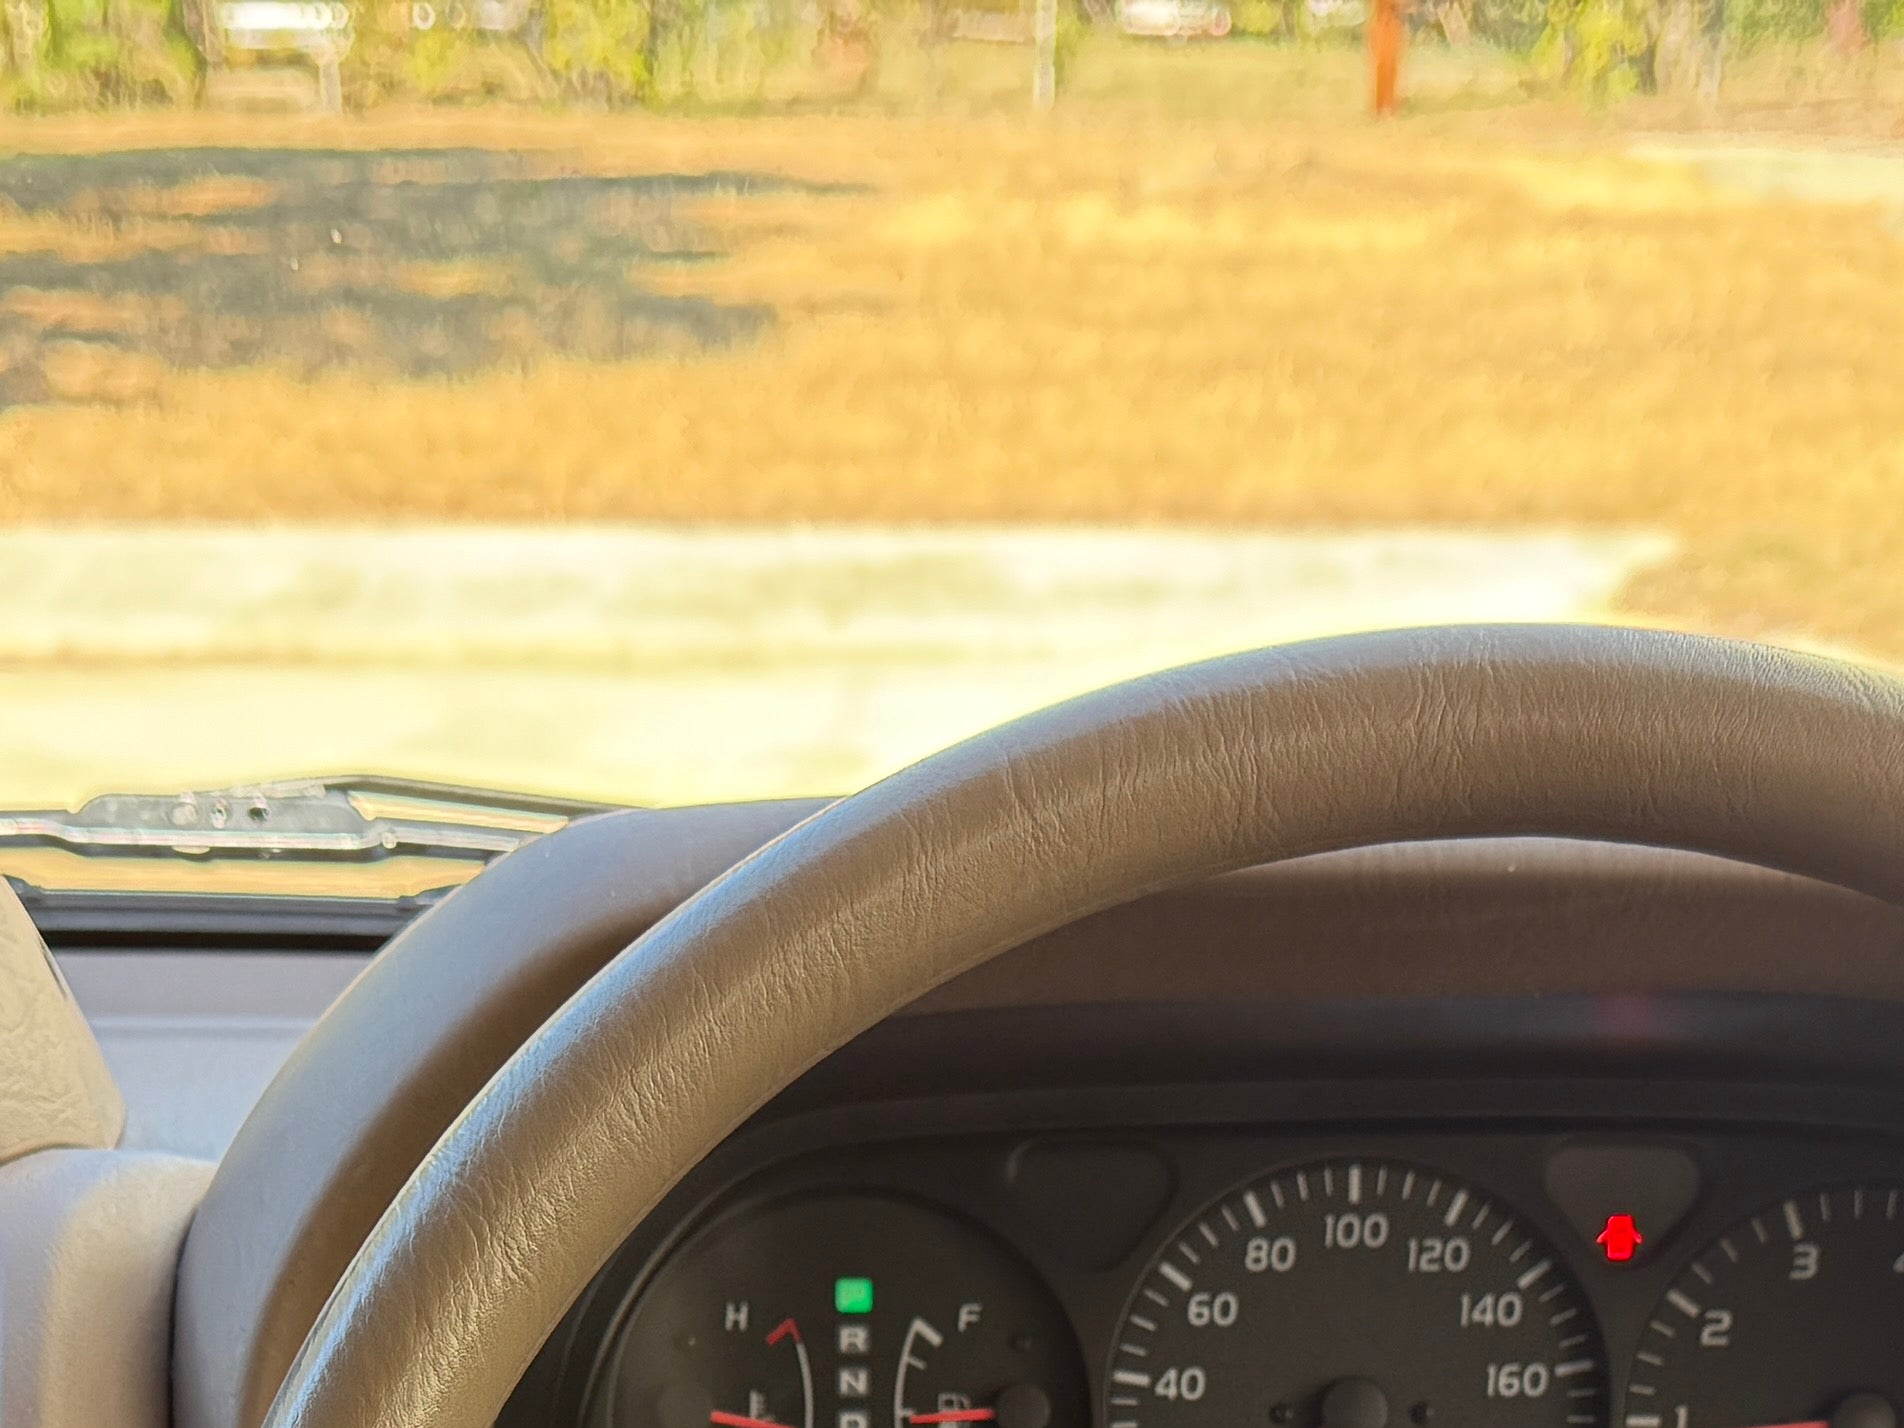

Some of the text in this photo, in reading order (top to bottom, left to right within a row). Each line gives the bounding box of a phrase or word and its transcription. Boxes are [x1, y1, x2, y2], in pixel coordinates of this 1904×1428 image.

[1325, 1213, 1389, 1249] 100
[1244, 1237, 1295, 1273] 80
[1407, 1238, 1471, 1273] 120
[1789, 1246, 1819, 1281] 3
[725, 1303, 749, 1329] H
[958, 1303, 983, 1330] F
[1187, 1292, 1239, 1328] 60
[1459, 1292, 1523, 1328] 140
[841, 1328, 868, 1351] R
[1700, 1311, 1732, 1347] 2
[840, 1370, 868, 1395] N
[1154, 1367, 1207, 1402] 40
[1486, 1366, 1549, 1399] 160
